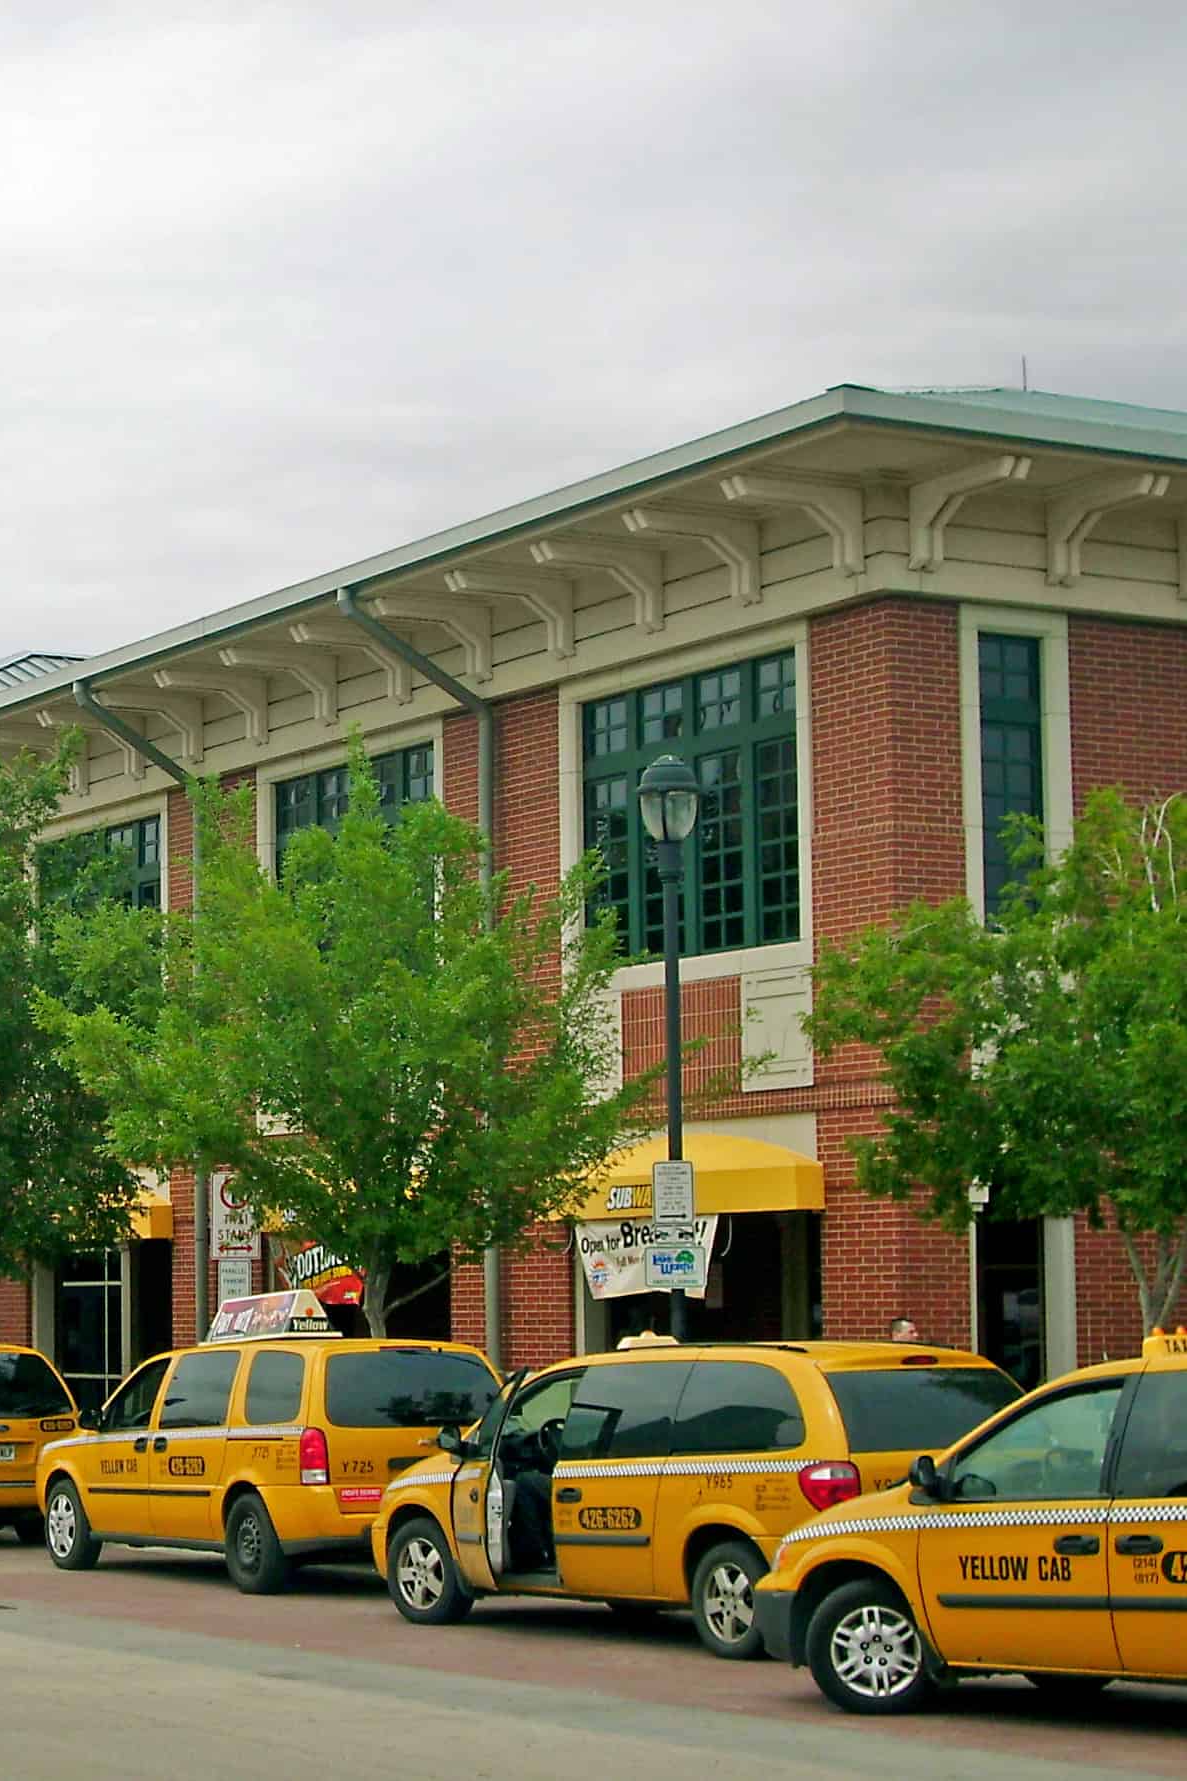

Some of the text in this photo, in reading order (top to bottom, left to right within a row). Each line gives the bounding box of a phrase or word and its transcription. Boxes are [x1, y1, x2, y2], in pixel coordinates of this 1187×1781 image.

[606, 1184, 653, 1210] SUBWA
[218, 1229, 254, 1242] STAND
[581, 1236, 604, 1257] Open
[605, 1233, 621, 1250] for
[293, 1319, 329, 1331] Yellow
[705, 1476, 733, 1489] Y965
[581, 1507, 637, 1530] 426-6262
[958, 1555, 1072, 1582] YELLOW CAB
